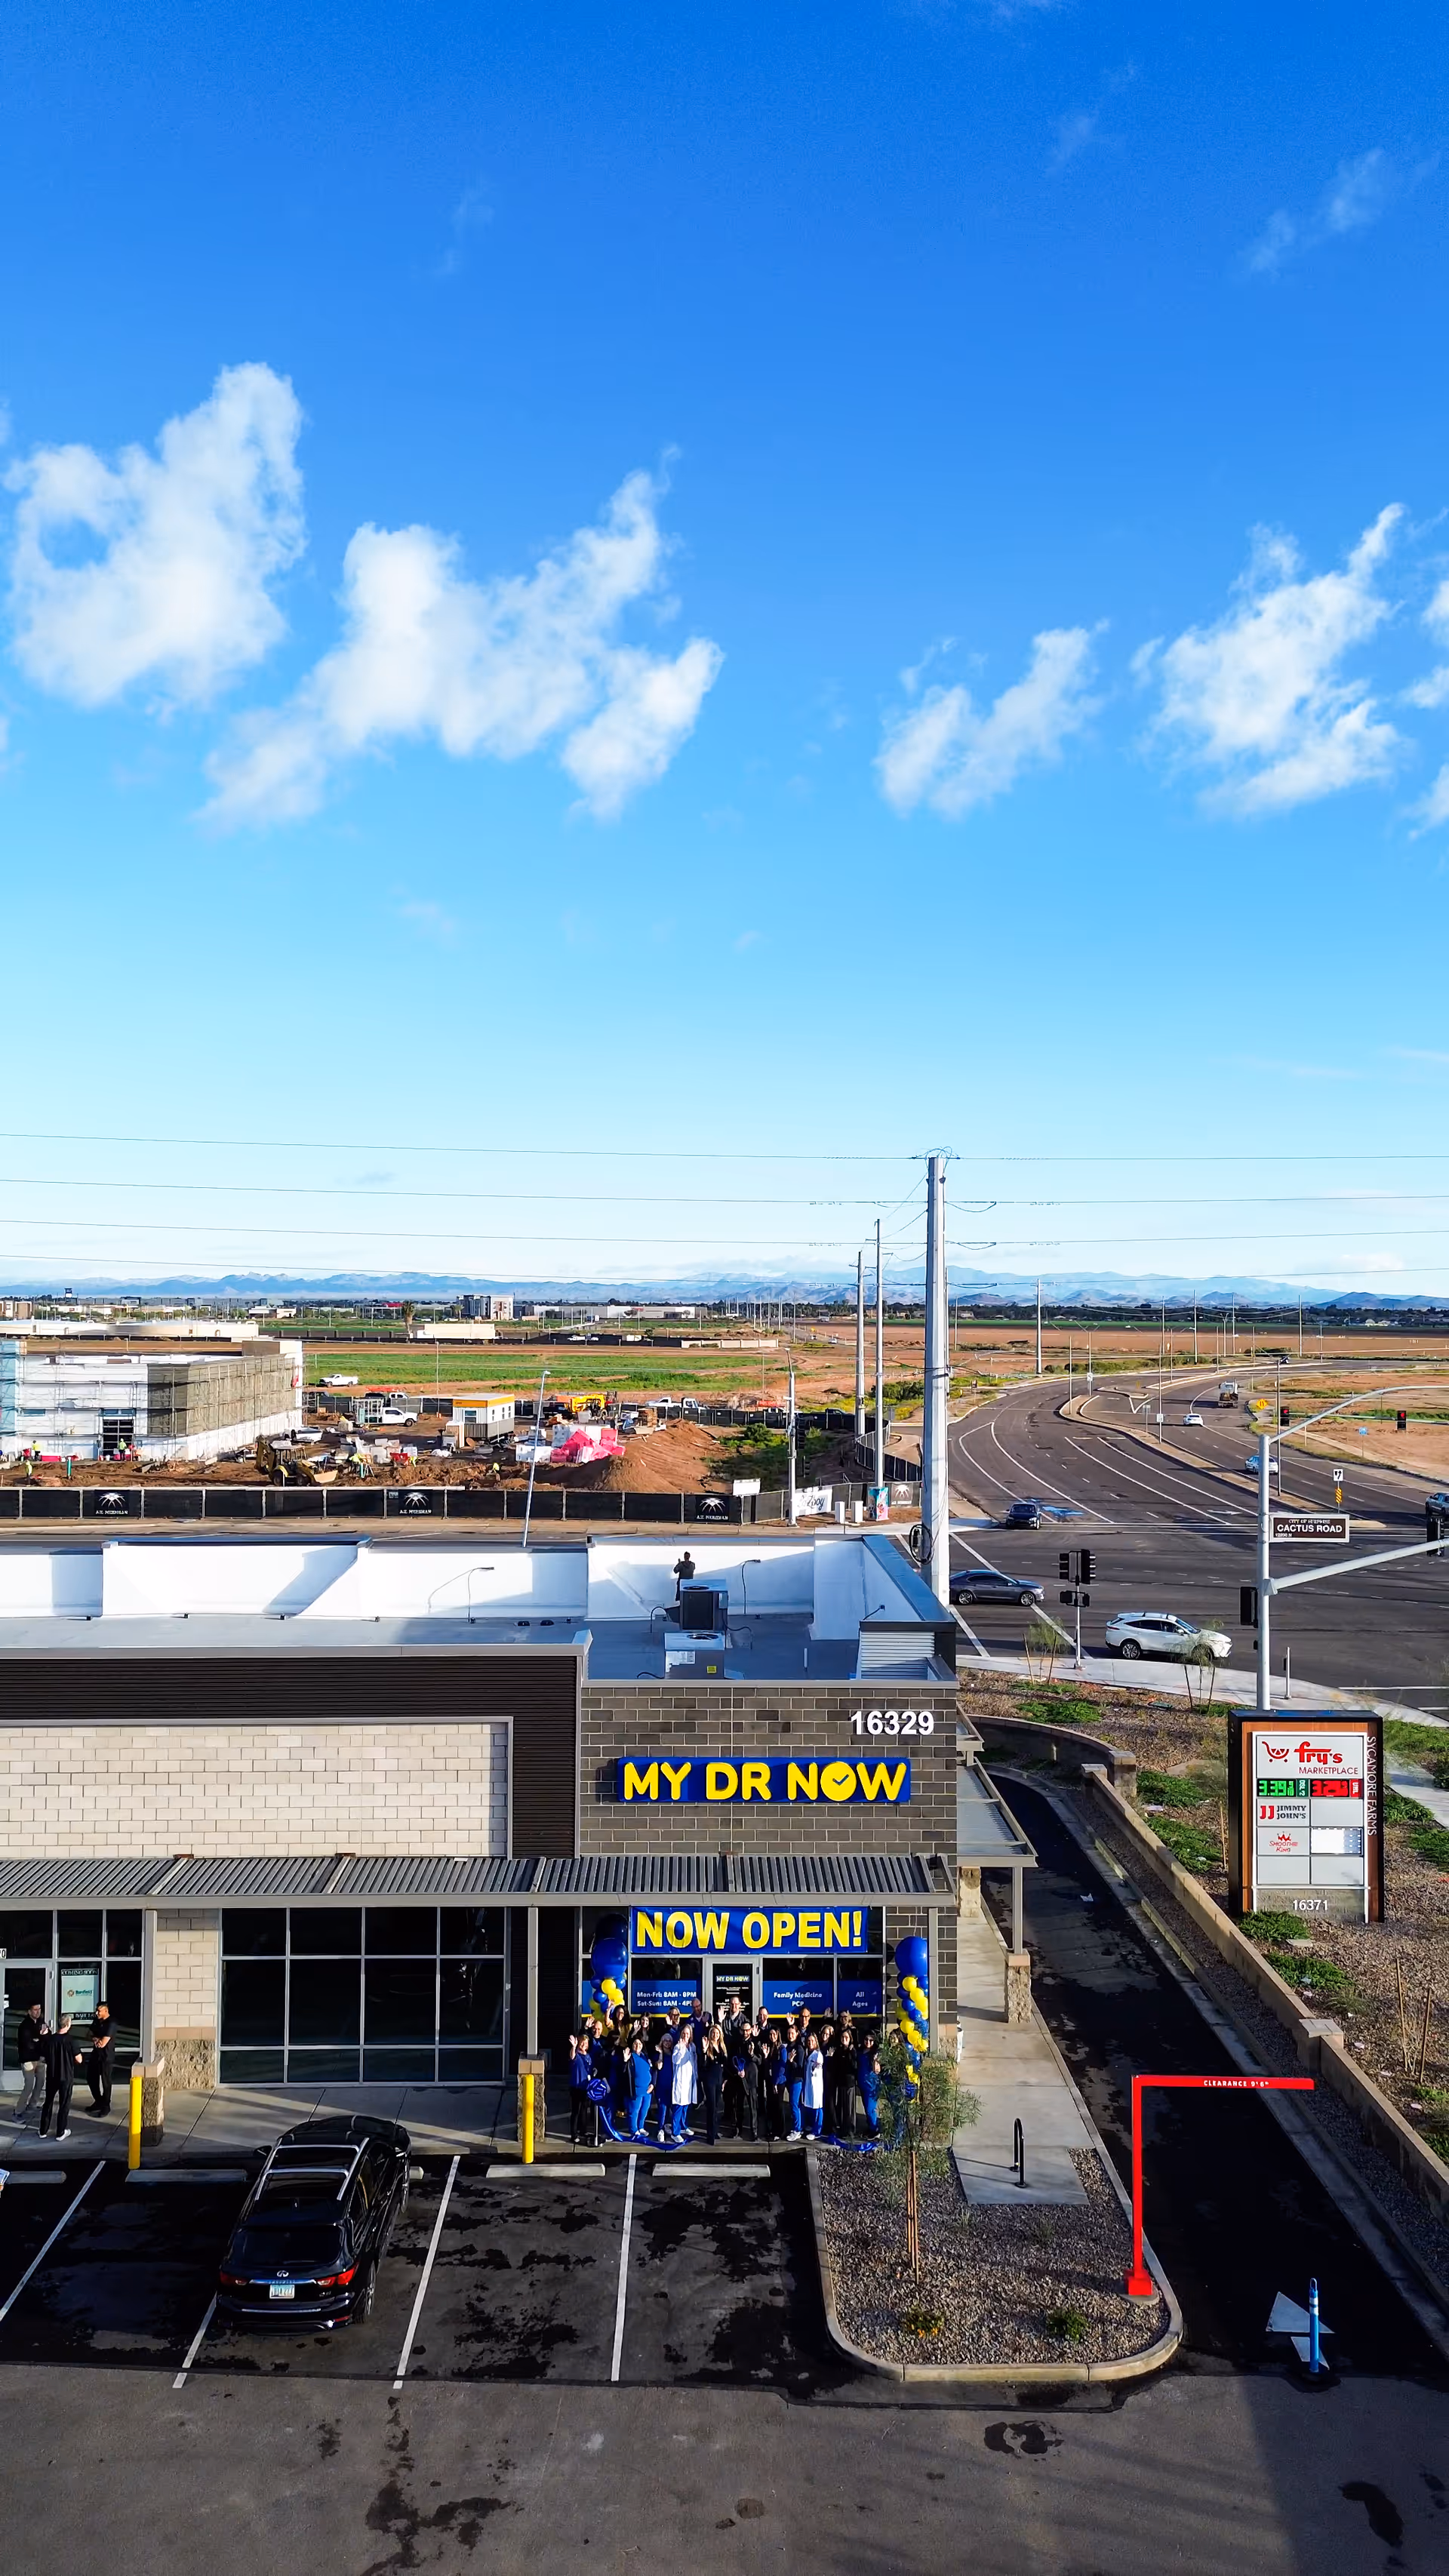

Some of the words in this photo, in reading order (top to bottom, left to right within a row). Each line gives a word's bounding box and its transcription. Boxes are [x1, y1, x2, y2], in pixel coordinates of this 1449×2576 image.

[1316, 1525, 1342, 1533] ROAD
[851, 1710, 934, 1735] 16329
[1294, 1741, 1343, 1765] fry's
[1367, 1736, 1377, 1796] SYCAMORE
[624, 1762, 692, 1801] MY
[706, 1762, 771, 1801] DR
[787, 1761, 907, 1802] NOW
[1260, 1805, 1275, 1820] JJ
[1367, 1799, 1377, 1836] FARMS
[1293, 1899, 1328, 1911] 16371
[637, 1911, 730, 1949] NOW
[742, 1910, 862, 1949] OPEN!
